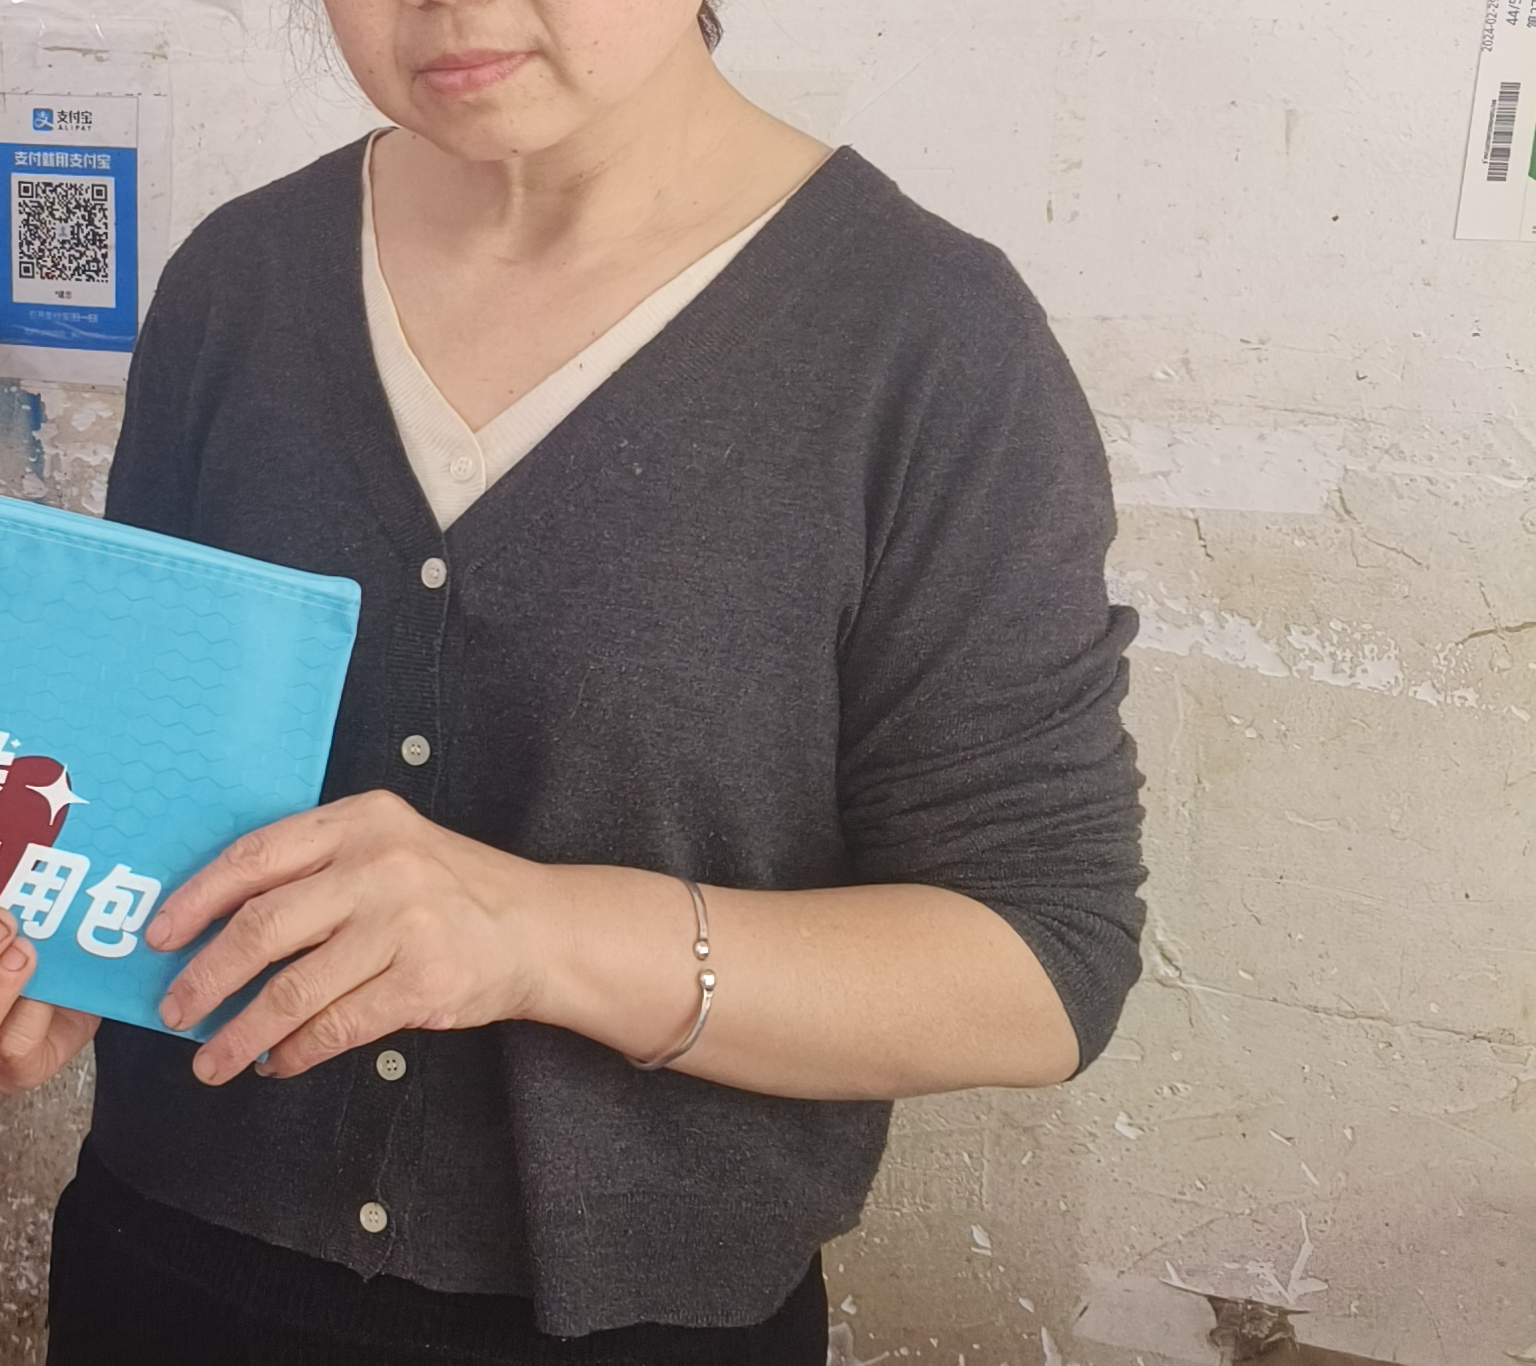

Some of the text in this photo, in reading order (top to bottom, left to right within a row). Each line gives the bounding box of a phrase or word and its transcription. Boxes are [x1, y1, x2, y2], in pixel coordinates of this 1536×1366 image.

[57, 110, 93, 125] 支付宝
[14, 151, 112, 170] 支付就用支付宝
